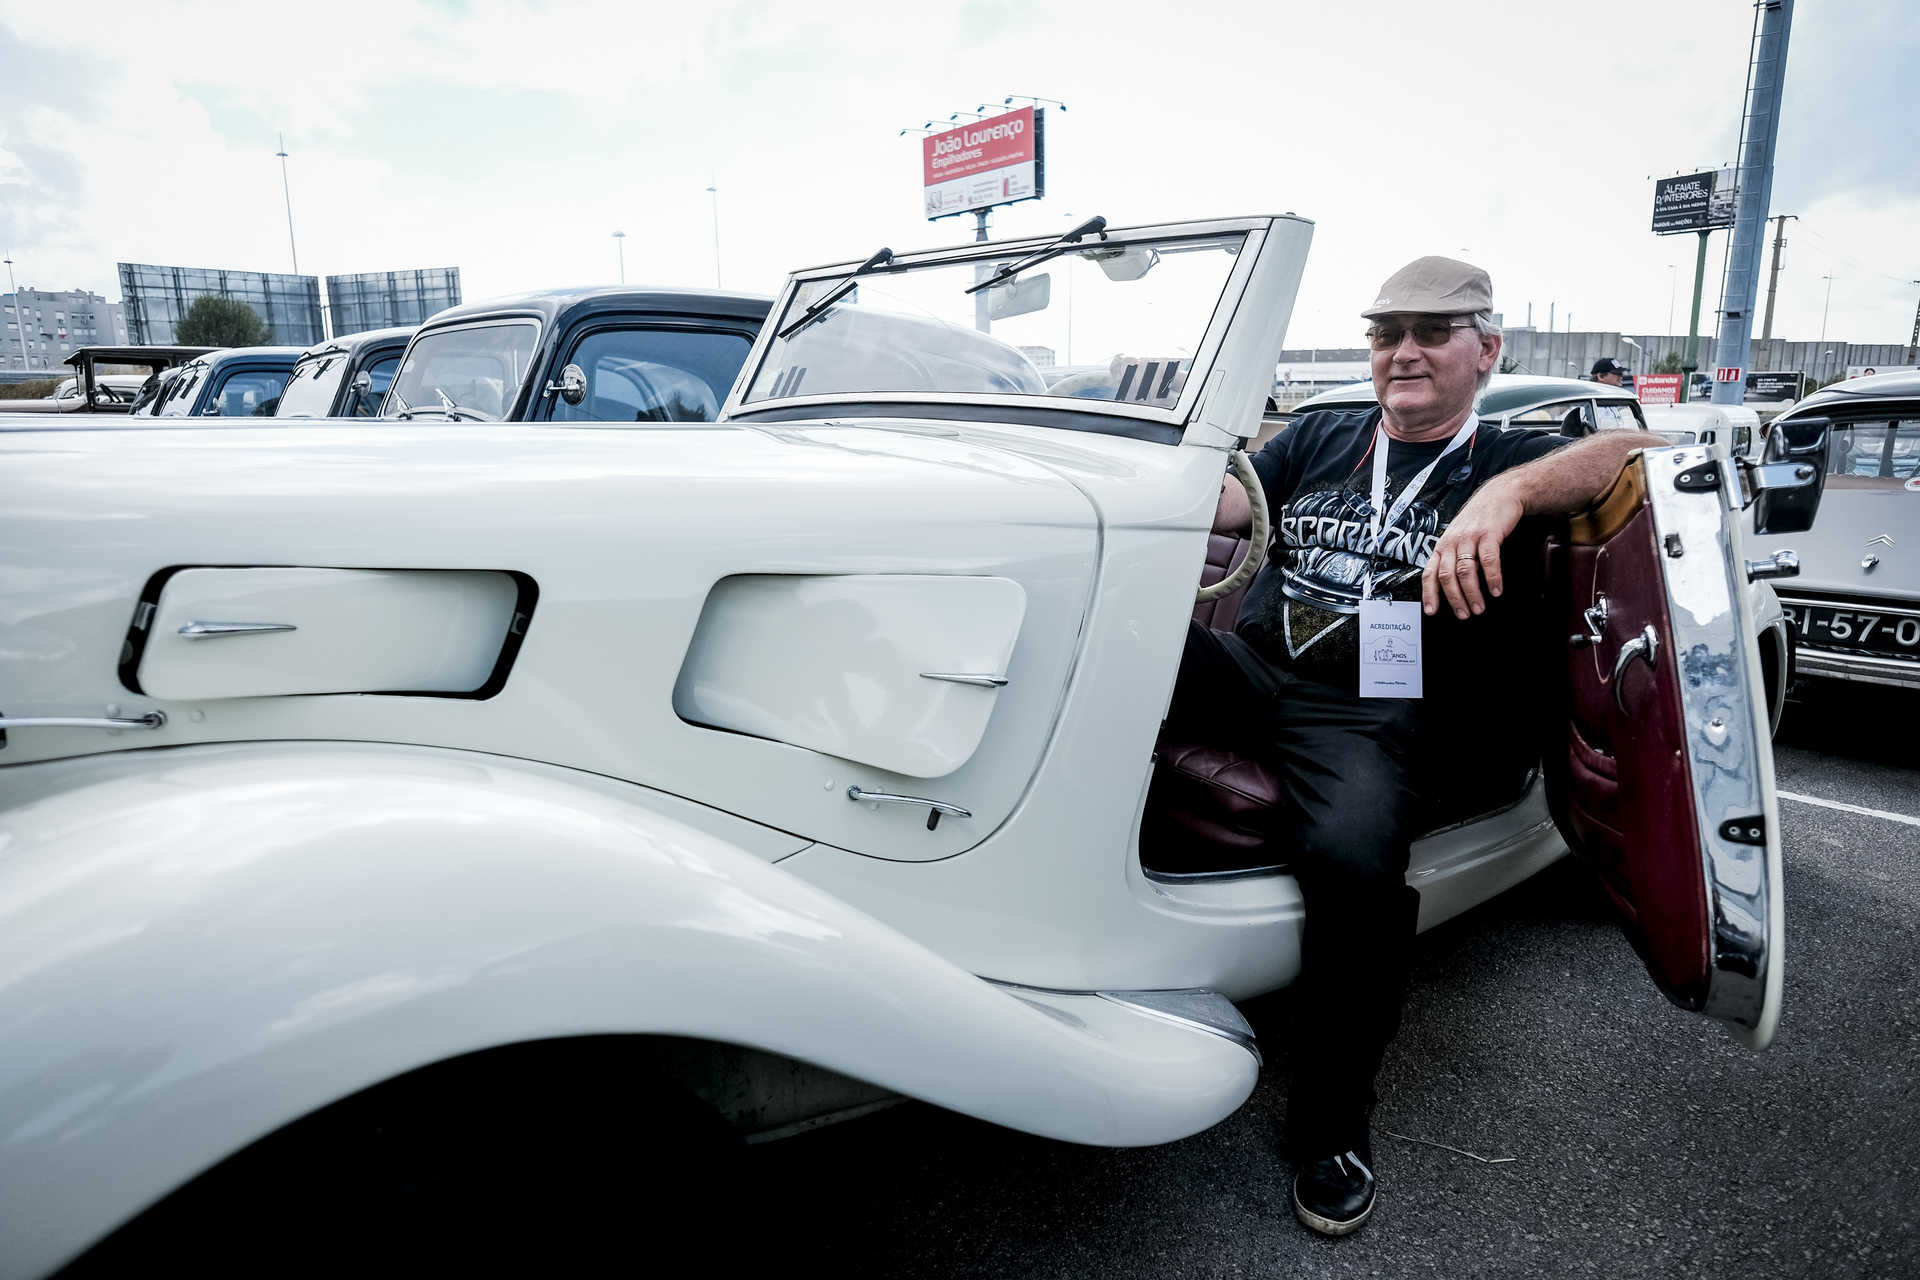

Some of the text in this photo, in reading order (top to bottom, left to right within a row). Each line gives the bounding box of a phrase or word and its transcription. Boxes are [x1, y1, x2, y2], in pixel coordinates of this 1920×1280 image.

[932, 119, 1024, 157] João Lourenço
[932, 148, 983, 169] Empilhadores
[1664, 181, 1701, 195] ALFAIATE
[1370, 623, 1411, 632] ACREDITAÇÃO
